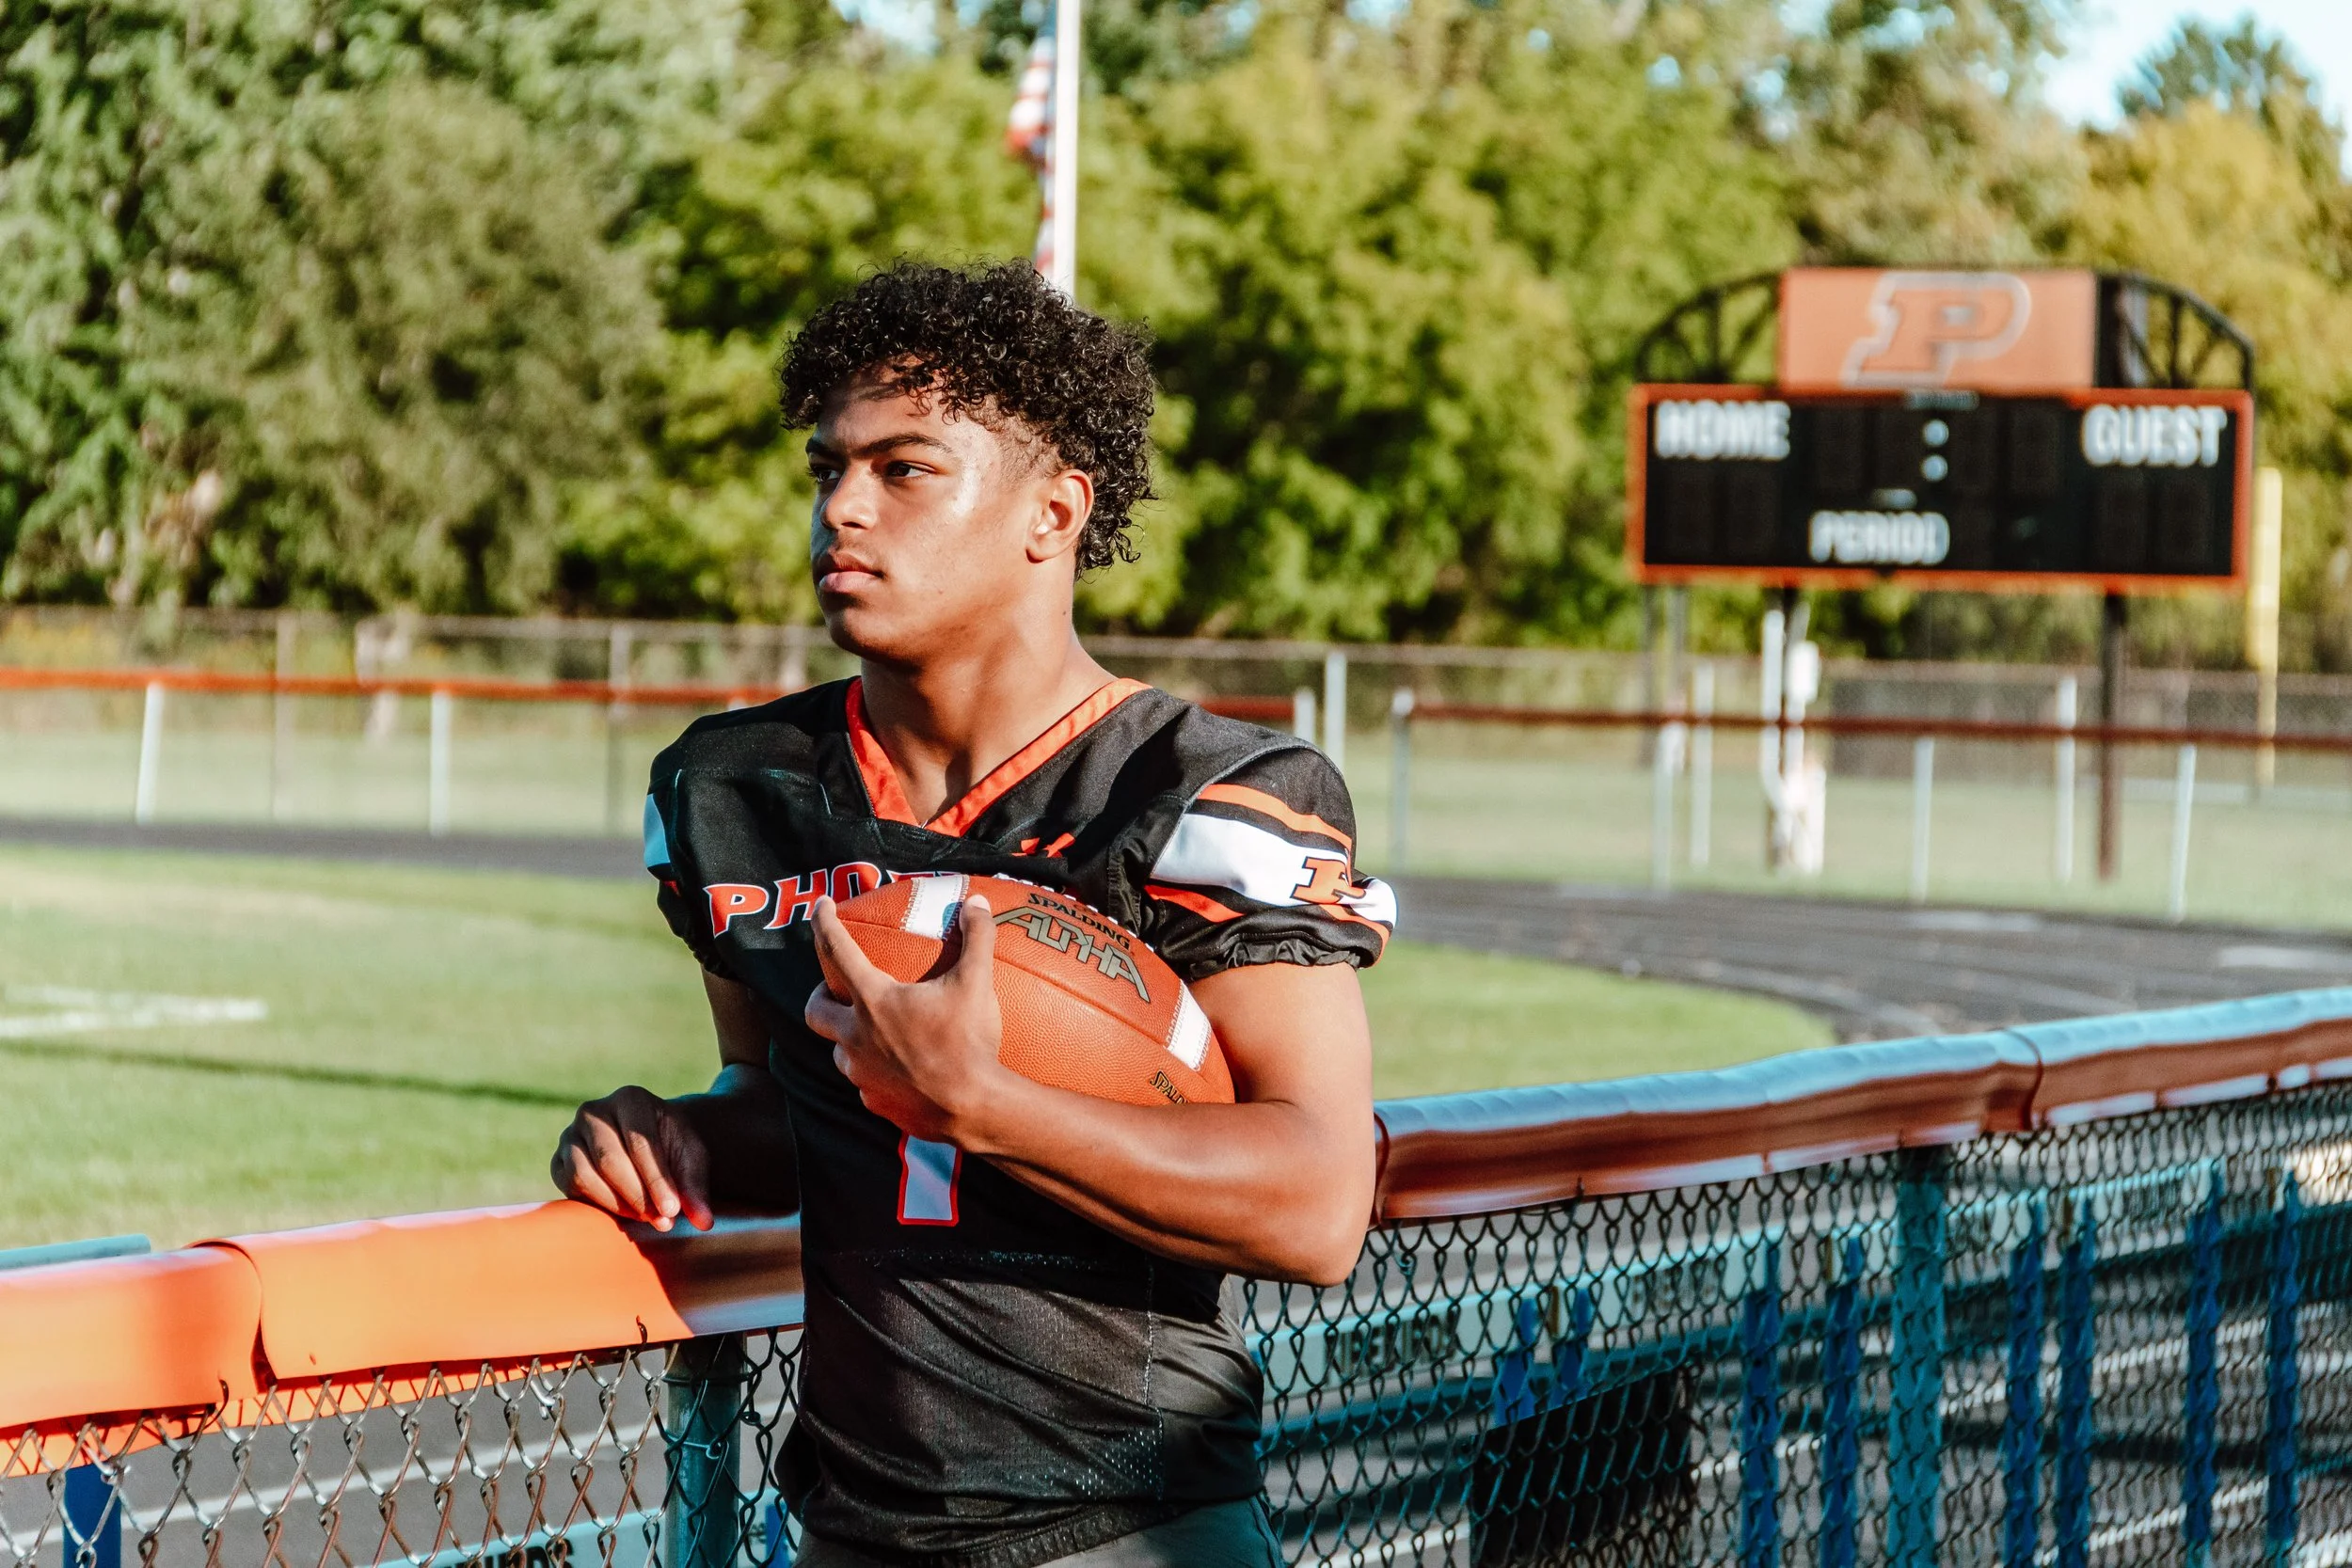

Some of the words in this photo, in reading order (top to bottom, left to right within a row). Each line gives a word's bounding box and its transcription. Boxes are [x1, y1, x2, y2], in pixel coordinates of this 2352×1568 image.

[1841, 271, 2033, 389] P
[1656, 399, 1791, 460] HOME
[2082, 404, 2228, 467] GUEST
[1809, 510, 1950, 565] PERIOD
[1026, 893, 1132, 952] SPALDING
[992, 905, 1152, 1005] ALPHA
[1149, 1069, 1190, 1105] SPALD
